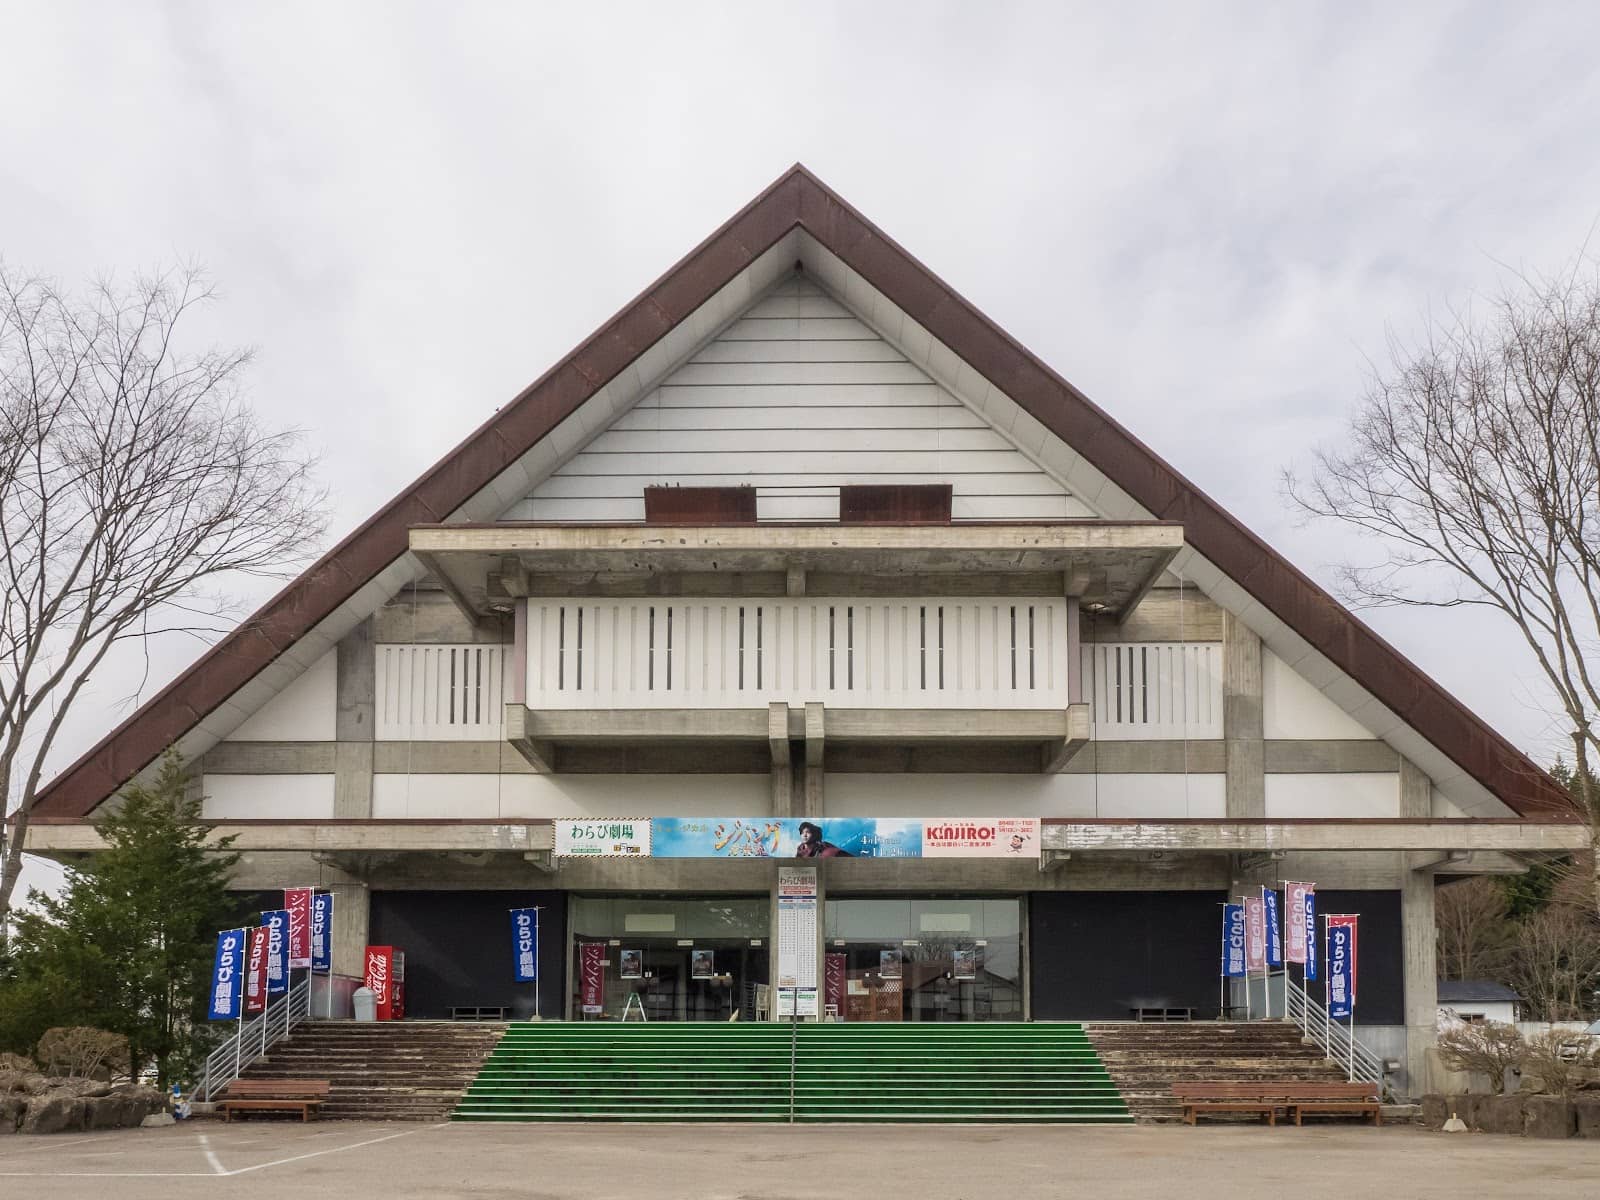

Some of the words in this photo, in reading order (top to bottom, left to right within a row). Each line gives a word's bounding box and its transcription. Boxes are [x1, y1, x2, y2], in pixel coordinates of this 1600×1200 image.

[571, 823, 634, 840] わらび劇場
[268, 915, 282, 981] わらび劇場
[313, 899, 325, 959] わらび劇場
[517, 914, 534, 977] わらび劇場
[214, 936, 237, 1015] わらび劇場
[247, 931, 265, 997] わらび劇場
[1332, 931, 1345, 1003] わらび劇場
